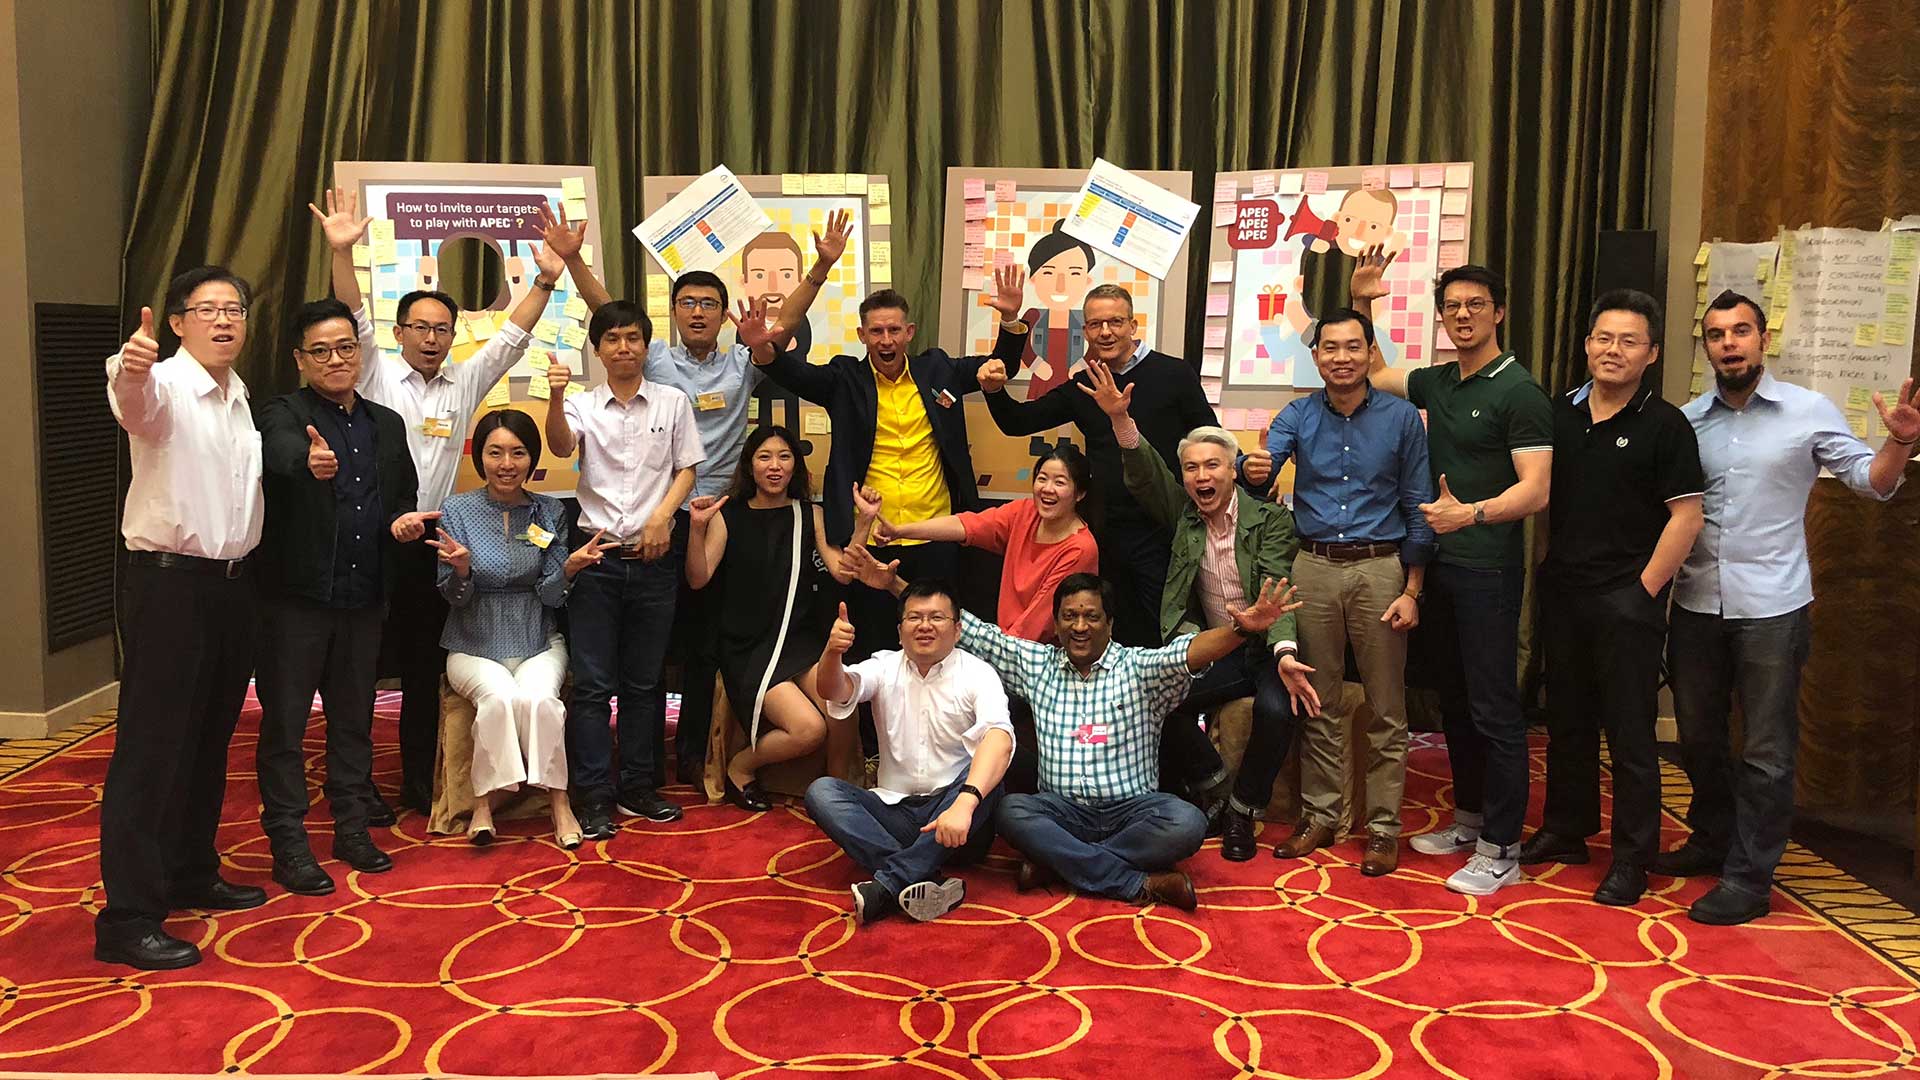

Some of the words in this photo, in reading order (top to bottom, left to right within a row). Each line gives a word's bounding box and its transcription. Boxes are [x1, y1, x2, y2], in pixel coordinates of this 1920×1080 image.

[396, 202, 422, 213] How
[425, 202, 437, 213] to
[440, 202, 473, 213] invite
[475, 205, 494, 214] our
[497, 203, 538, 217] targets
[1239, 207, 1269, 218] APEC
[410, 217, 423, 227] to
[425, 217, 450, 230] play
[453, 217, 478, 228] with
[1238, 218, 1268, 229] APEC
[1237, 230, 1267, 240] APEC
